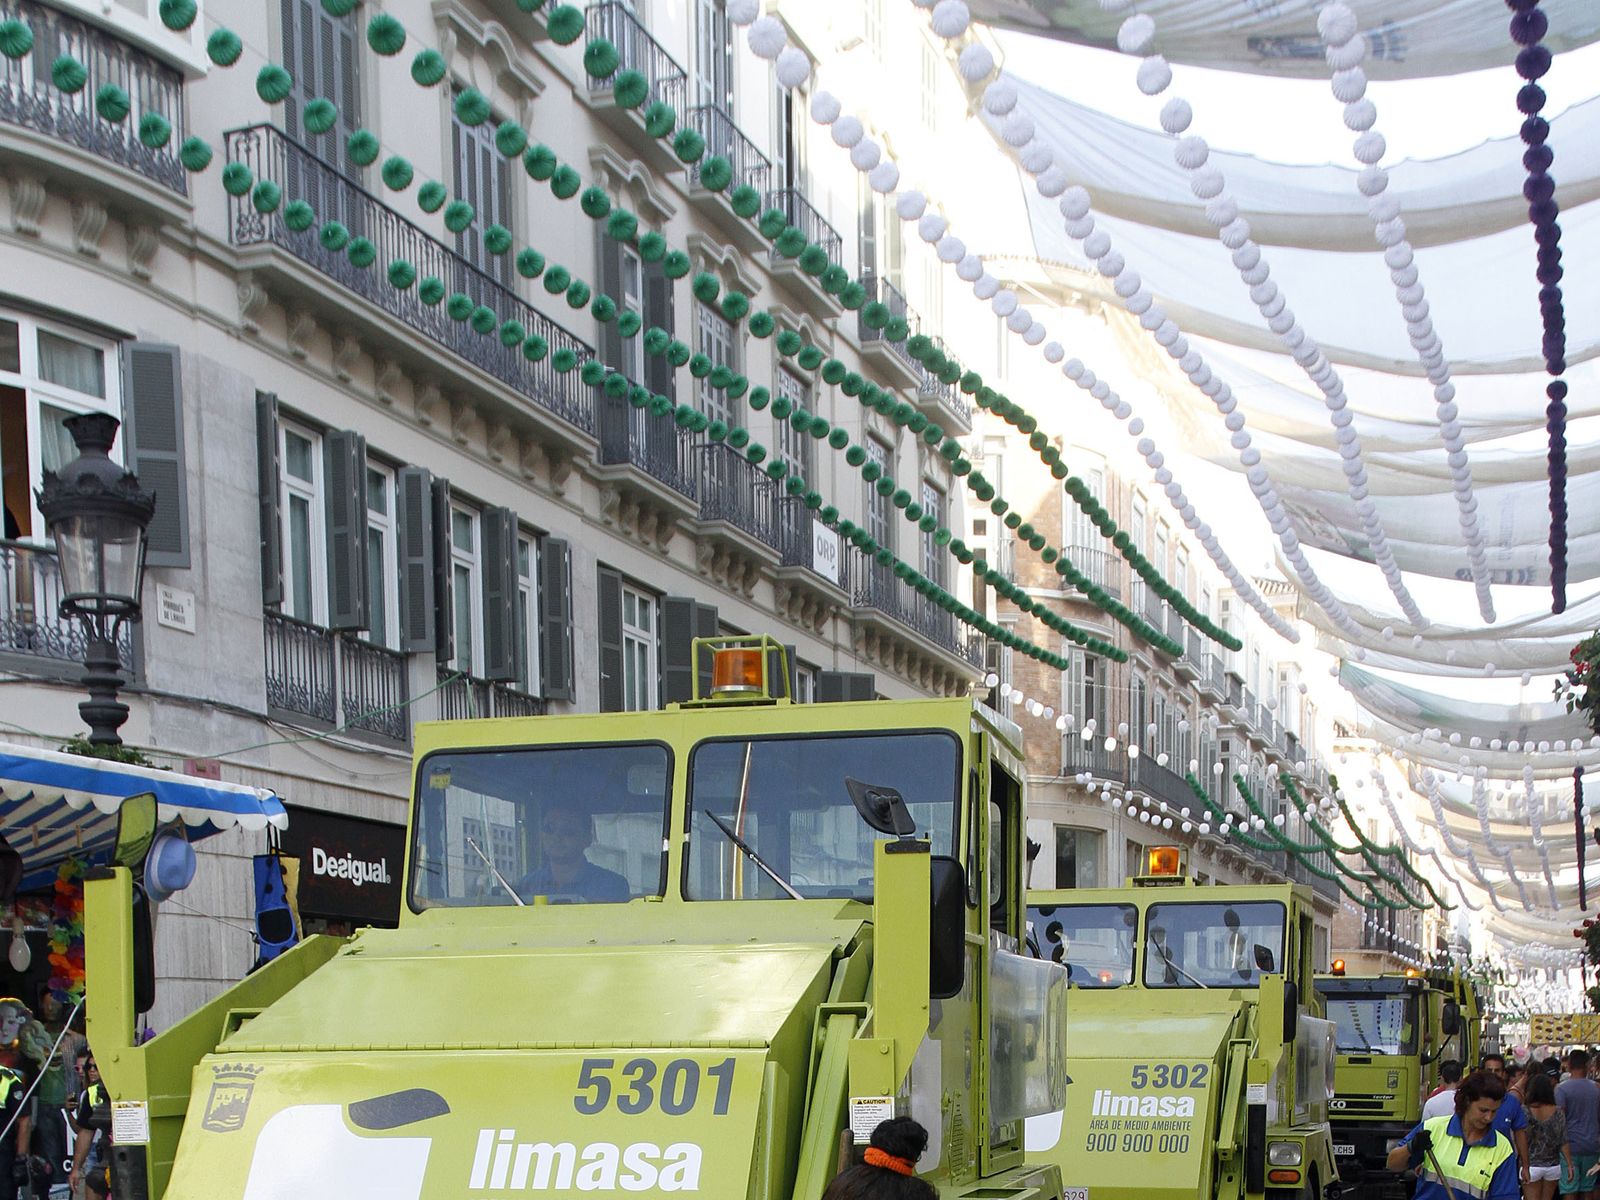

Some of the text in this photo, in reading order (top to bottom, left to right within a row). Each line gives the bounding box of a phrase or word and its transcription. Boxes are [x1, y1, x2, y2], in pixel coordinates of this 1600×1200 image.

[573, 1057, 737, 1117] 5301
[1131, 1063, 1209, 1089] 5302
[1091, 1089, 1196, 1118] limasa
[1111, 1120, 1122, 1131] DE
[1124, 1120, 1150, 1131] MEDIO
[1151, 1120, 1192, 1132] AMBIENTE
[1086, 1133, 1190, 1154] 900 900 000
[468, 1128, 703, 1192] limasa
